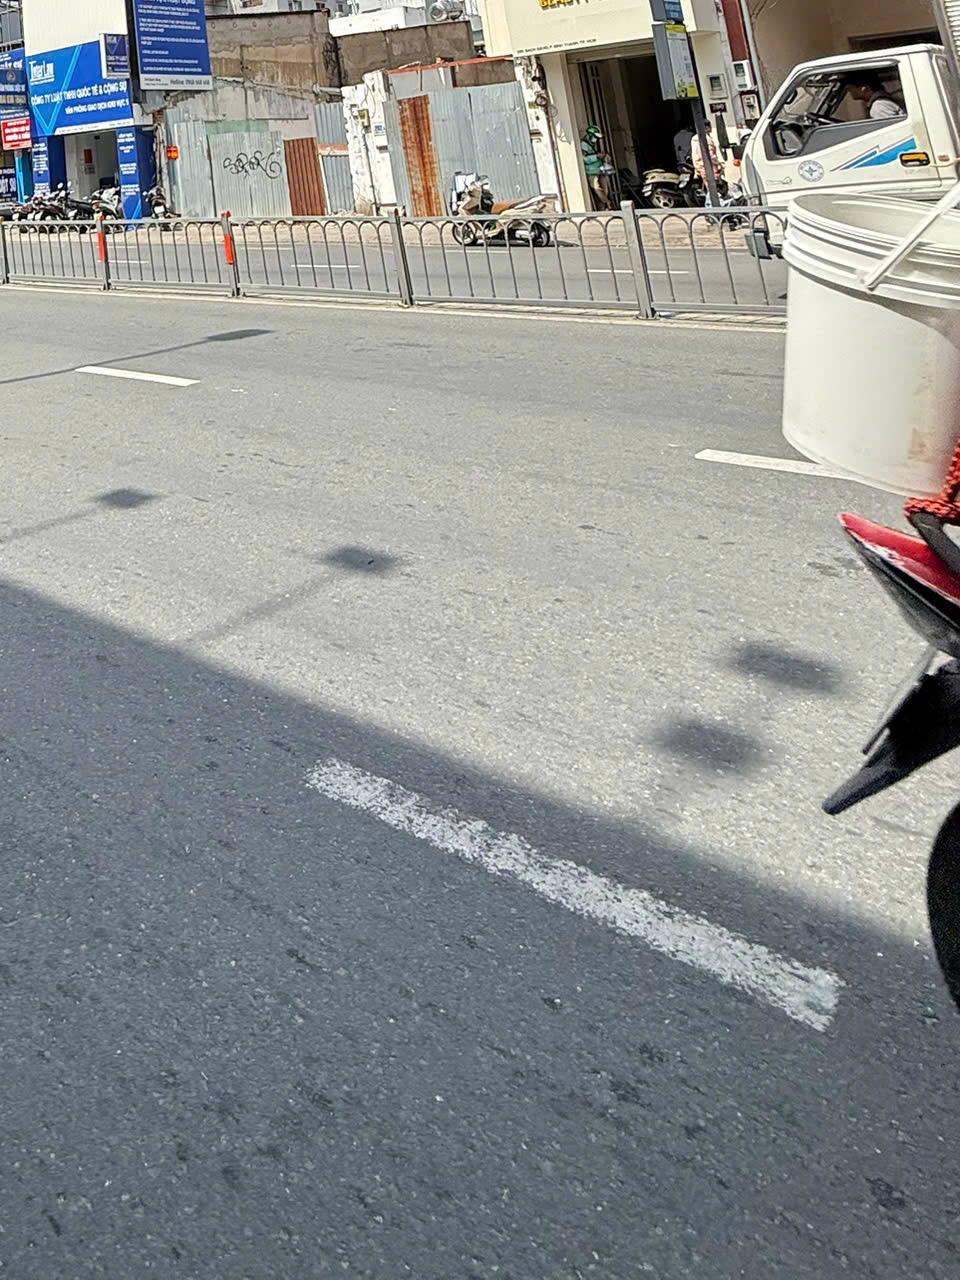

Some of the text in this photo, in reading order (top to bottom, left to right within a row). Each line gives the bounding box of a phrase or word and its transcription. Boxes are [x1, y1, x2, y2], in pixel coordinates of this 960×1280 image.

[31, 93, 44, 106] CÔNG
[44, 94, 51, 104] TY
[76, 86, 91, 98] QUỐC
[91, 84, 98, 96] TẾ
[103, 83, 118, 95] CỘNG
